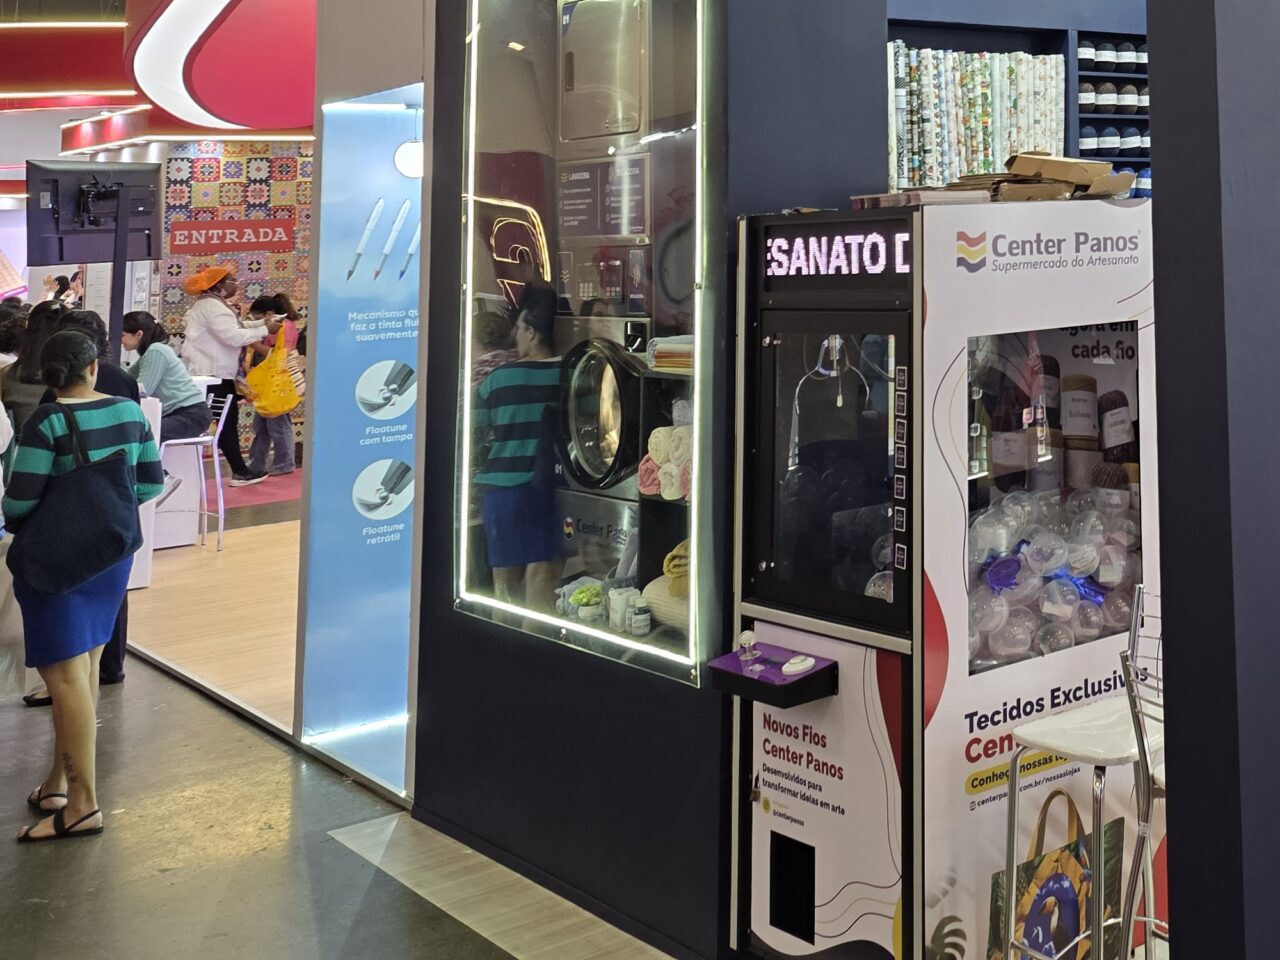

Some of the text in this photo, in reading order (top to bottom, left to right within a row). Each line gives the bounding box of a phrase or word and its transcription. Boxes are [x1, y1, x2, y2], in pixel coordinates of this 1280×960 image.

[173, 227, 289, 245] ENTRADA
[992, 232, 1139, 258] Center Panos
[992, 254, 1139, 274] Supermercado do Artesanato
[348, 309, 406, 321] Mecanismo
[350, 322, 368, 332] faz
[378, 320, 402, 330] tinta
[355, 330, 419, 342] suavemente
[1071, 340, 1136, 360] cada fio
[360, 433, 414, 446] com tampa
[366, 533, 400, 545] retrátil
[965, 667, 1149, 734] Tecidos Exclusivs
[763, 712, 827, 748] Novos Fios
[762, 738, 844, 781] Center Panos
[762, 762, 823, 793] Desenvolvidos para
[971, 754, 1053, 790] Conheç nossas
[762, 778, 799, 799] transformar
[800, 790, 819, 806] ideias
[819, 800, 831, 810] em
[831, 804, 846, 816] arte
